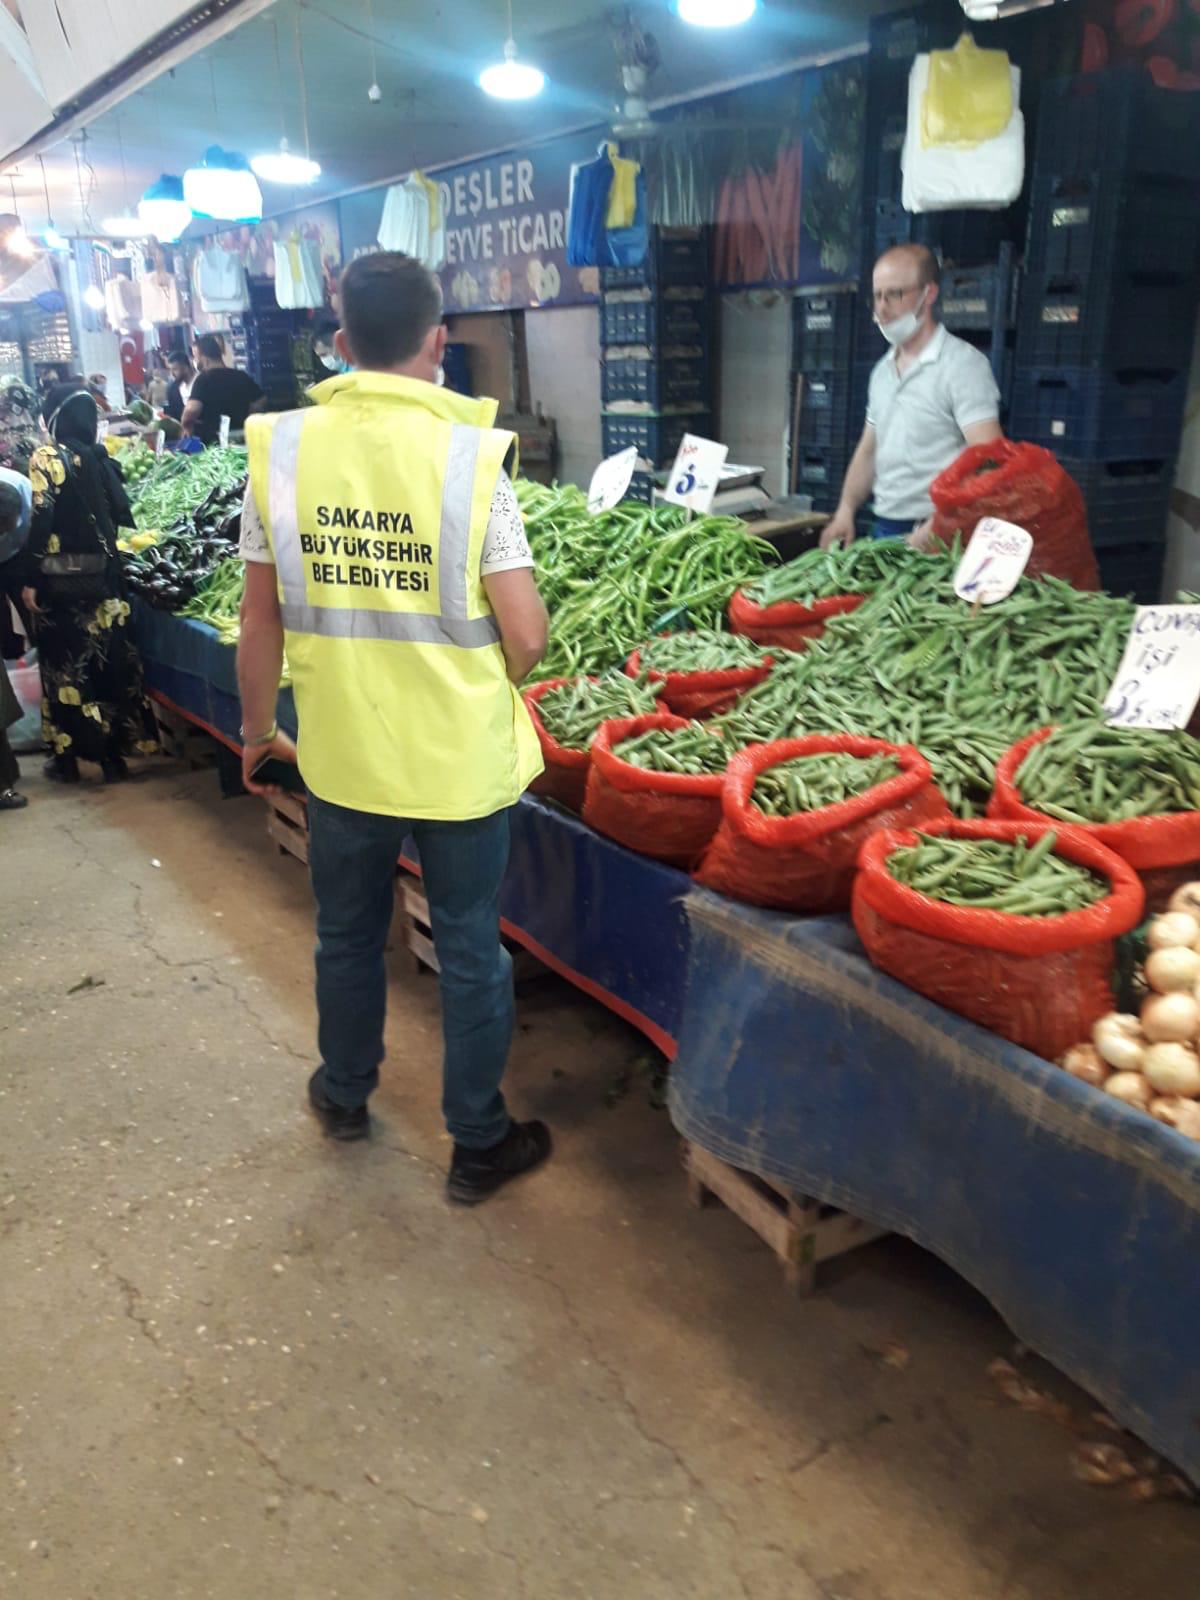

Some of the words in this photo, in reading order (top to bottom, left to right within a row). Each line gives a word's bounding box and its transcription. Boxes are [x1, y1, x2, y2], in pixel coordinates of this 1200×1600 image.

[444, 223, 493, 265] EYVE
[499, 209, 570, 257] TİCAR
[316, 505, 415, 535] SAKARYA
[300, 533, 434, 566] BÜYÜKŞEHİR
[312, 562, 430, 592] BELEDİYESİ
